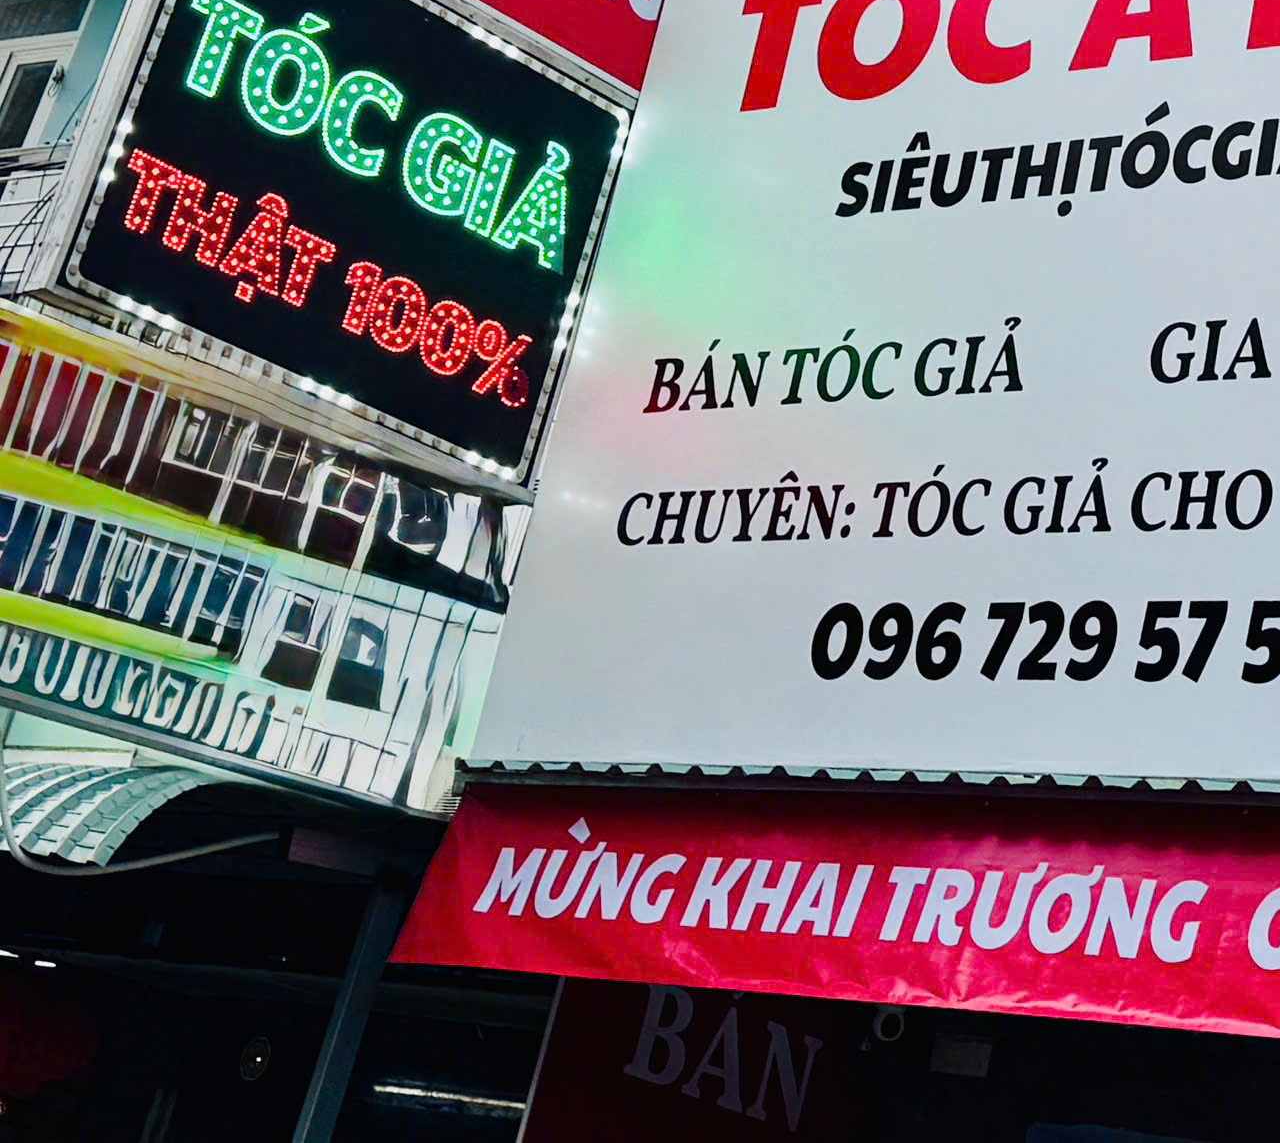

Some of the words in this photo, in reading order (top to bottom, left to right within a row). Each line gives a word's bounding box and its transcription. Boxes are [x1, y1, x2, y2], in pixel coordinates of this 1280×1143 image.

[402, 111, 571, 274] GIẢ
[123, 149, 336, 308] THẬT
[341, 260, 533, 408] 100%
[643, 339, 770, 414] BÁN
[780, 329, 902, 405] TÓC
[913, 317, 1024, 397] GIẢ
[1149, 318, 1272, 384] GIA
[616, 470, 856, 545] CHUYÊN:
[872, 464, 991, 539] TÓC
[1003, 457, 1112, 535] GIẢ
[1130, 469, 1273, 532] CHO
[810, 601, 967, 681] 096
[980, 600, 1118, 682] 729
[1134, 600, 1229, 683] 57
[473, 817, 688, 923] MỪNG
[680, 857, 875, 939] KHAI
[879, 862, 1209, 963] TRƯƠNG
